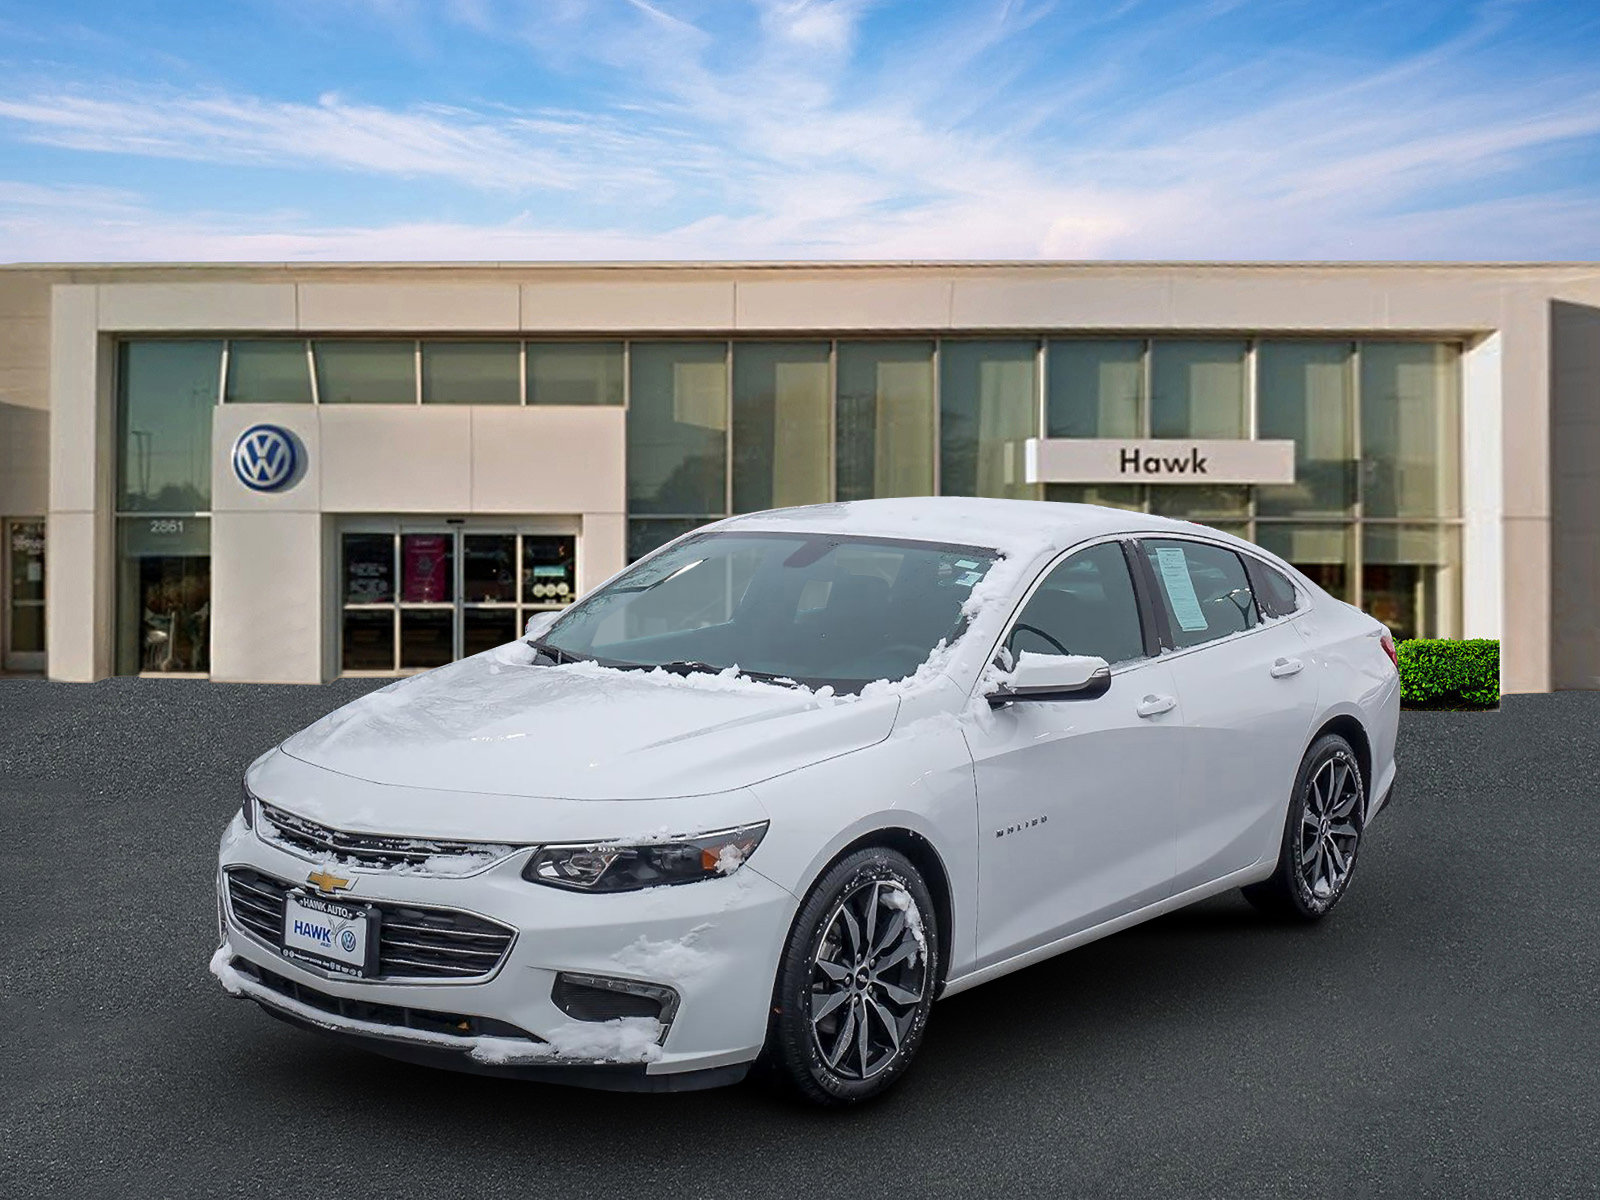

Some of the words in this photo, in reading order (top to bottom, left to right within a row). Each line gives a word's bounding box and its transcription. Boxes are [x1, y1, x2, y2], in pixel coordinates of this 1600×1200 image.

[1120, 447, 1207, 474] Hawk
[303, 898, 327, 912] HAWK
[327, 904, 348, 918] AUTO
[294, 920, 331, 943] HAWK
